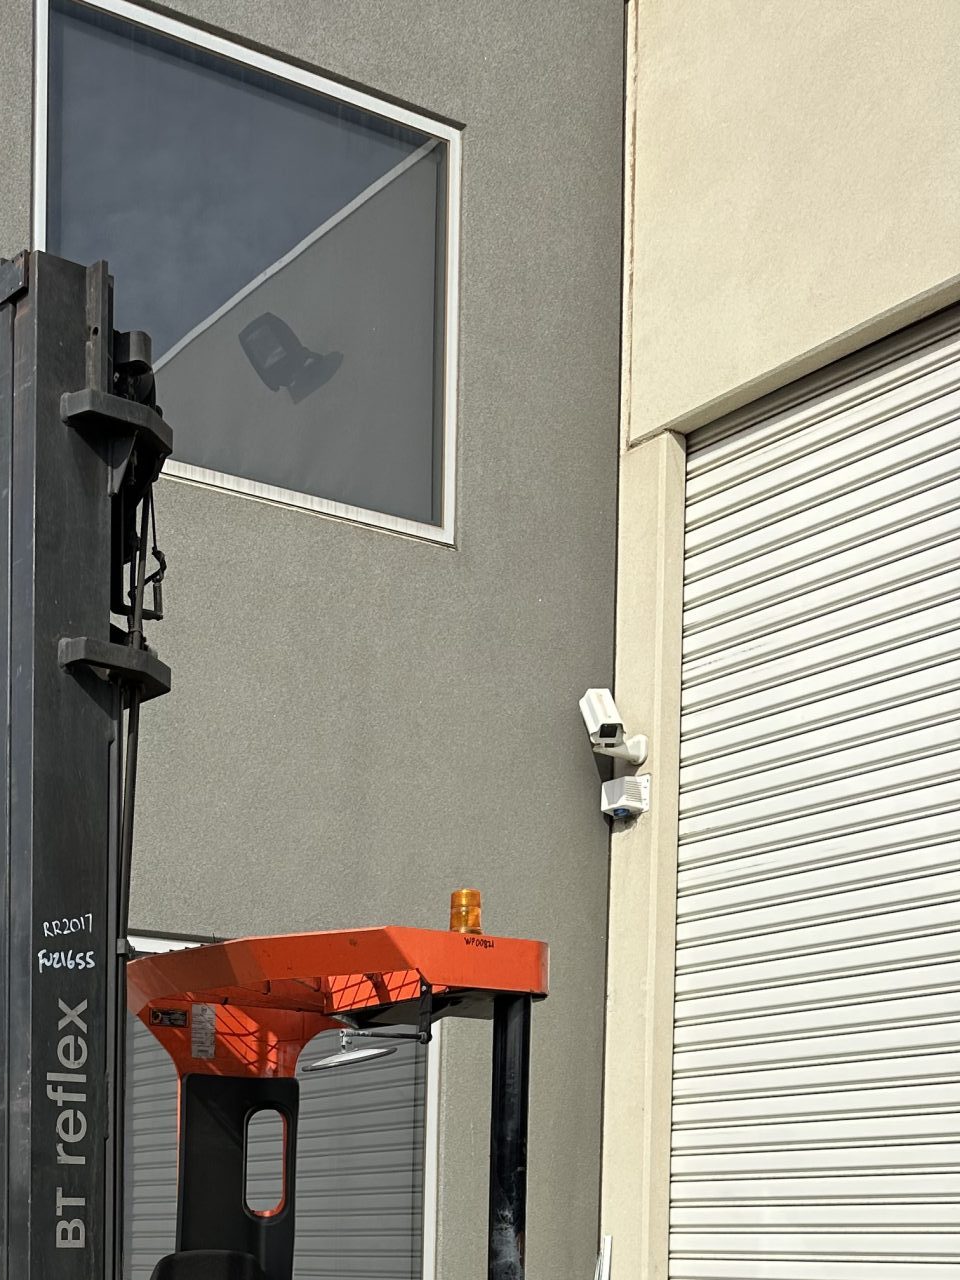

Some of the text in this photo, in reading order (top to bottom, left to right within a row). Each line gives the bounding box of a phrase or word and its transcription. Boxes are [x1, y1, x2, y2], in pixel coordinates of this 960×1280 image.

[43, 913, 93, 937] RR2017
[46, 998, 89, 1248] BT reflex
